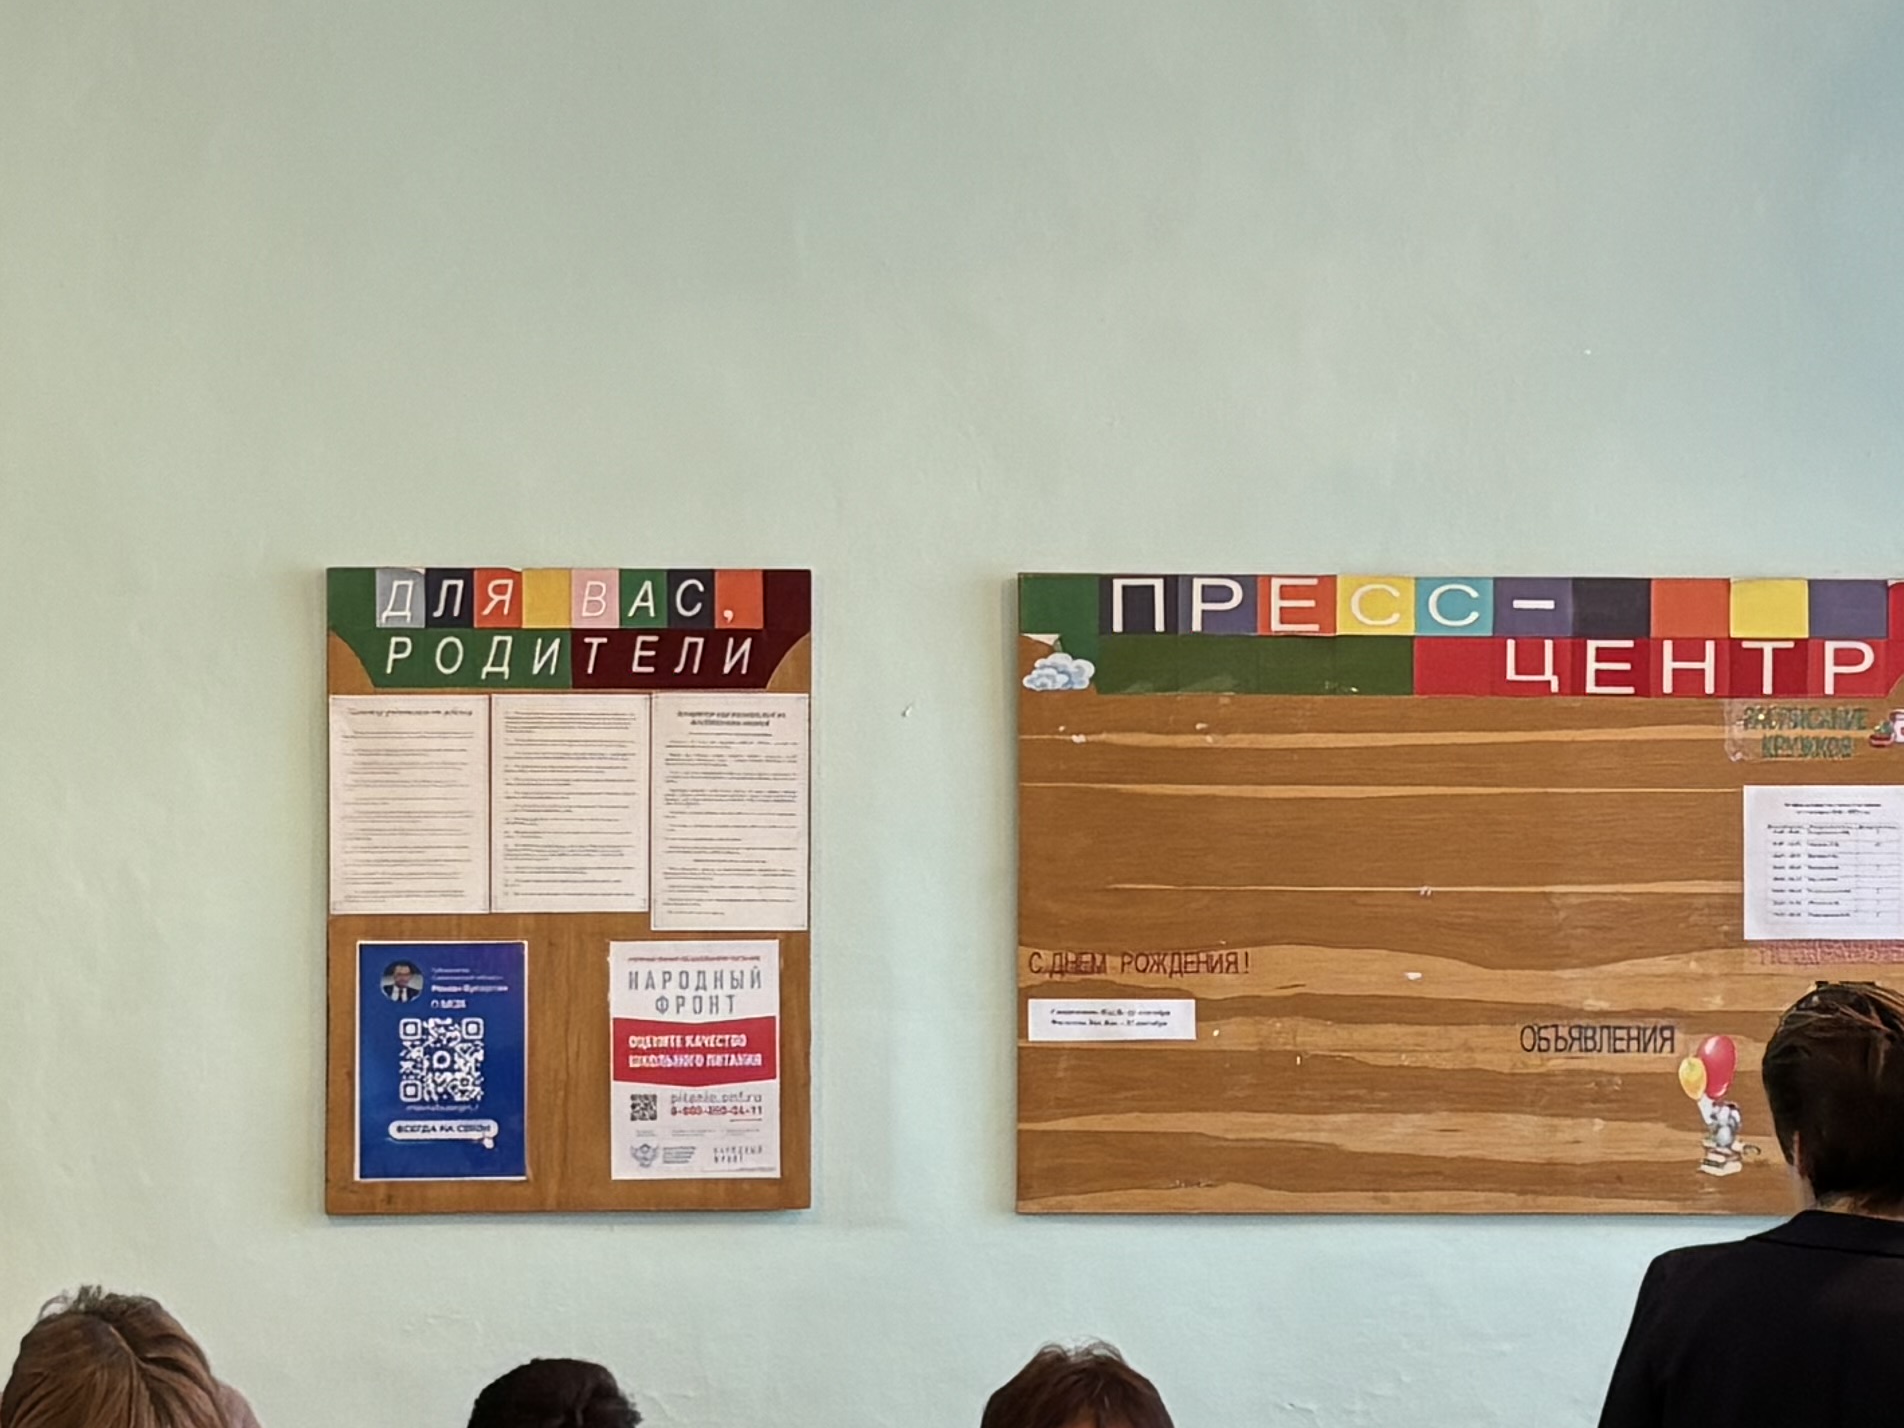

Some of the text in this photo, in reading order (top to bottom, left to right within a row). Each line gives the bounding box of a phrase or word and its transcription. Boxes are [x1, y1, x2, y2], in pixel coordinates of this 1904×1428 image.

[381, 579, 734, 622] ДЛЯ ВАС,
[1112, 577, 1555, 632] ПРЕСС-
[386, 636, 752, 680] РОДИТЕЛИ
[1506, 639, 1875, 694] ЦЕНТР
[628, 966, 762, 991] НАРОДНЫЙ
[1028, 952, 1043, 973] С
[655, 994, 736, 1015] ФРОНТ
[1520, 1024, 1675, 1053] ОБЪЯВЛЕНИЯ
